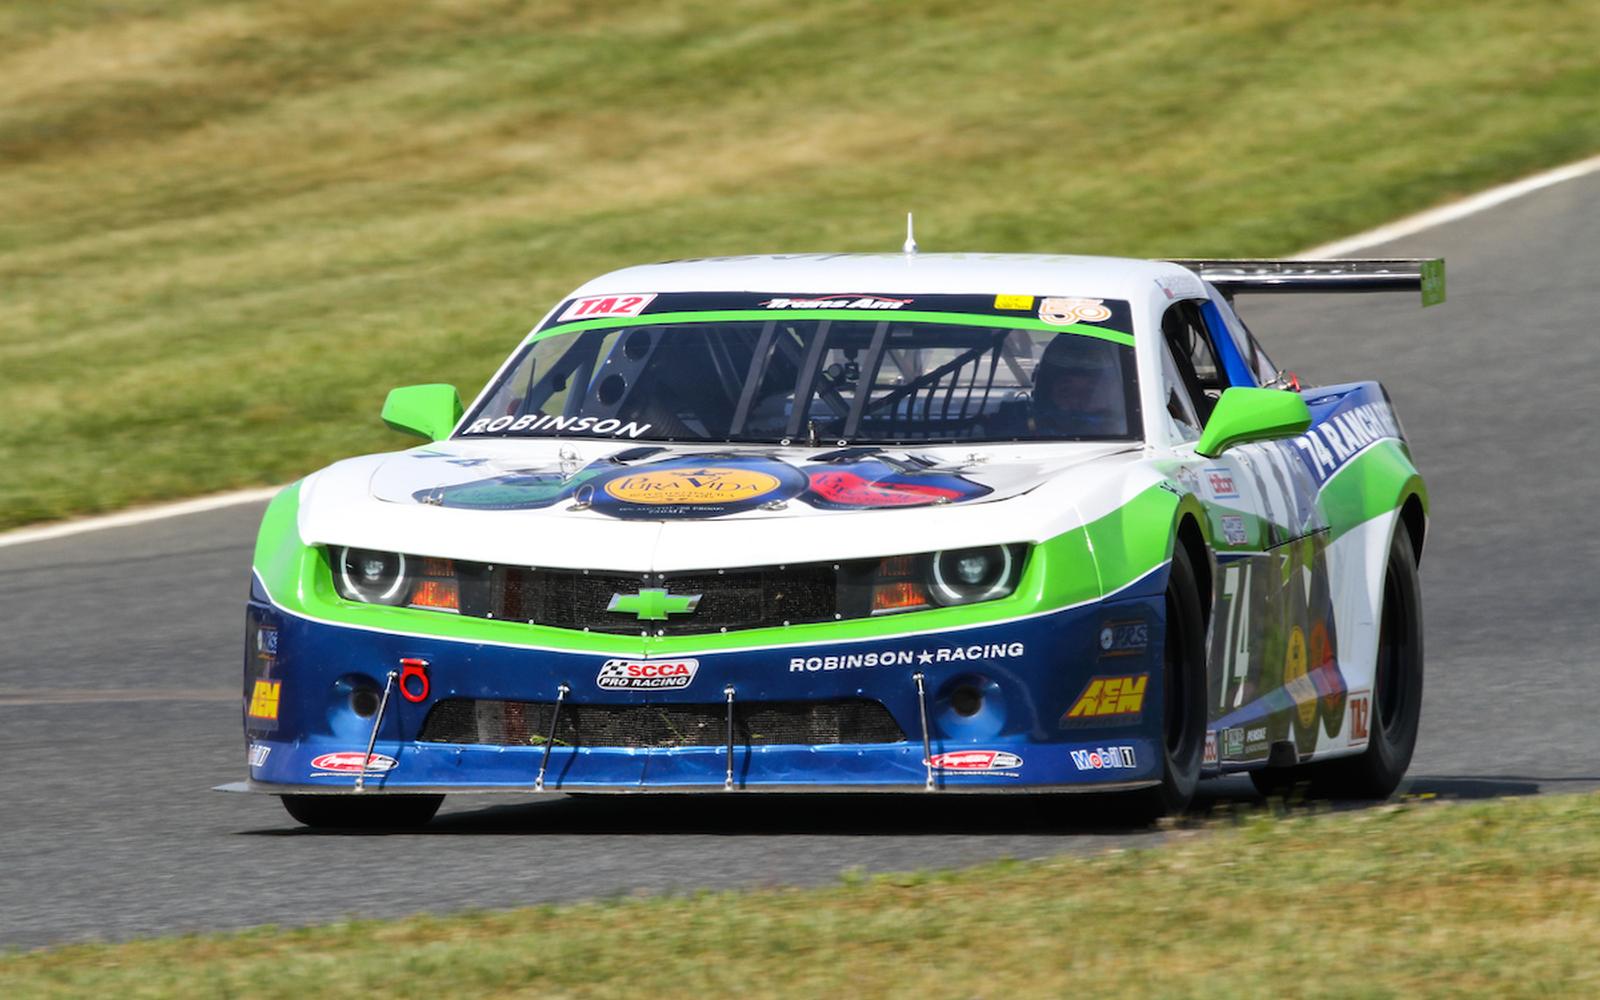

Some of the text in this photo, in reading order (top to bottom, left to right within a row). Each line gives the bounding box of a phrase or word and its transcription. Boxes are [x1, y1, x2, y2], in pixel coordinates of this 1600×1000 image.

[574, 297, 643, 316] TA2
[766, 299, 904, 309] Trans Am
[463, 415, 651, 439] ROBINSON
[1294, 430, 1337, 481] 74
[1219, 562, 1252, 709] 74
[789, 642, 1025, 672] ROBINSON RACING
[600, 677, 688, 687] PRO RACING
[627, 664, 690, 677] SCCA
[1066, 674, 1149, 717] AEM
[1070, 746, 1137, 770] Mobil 1
